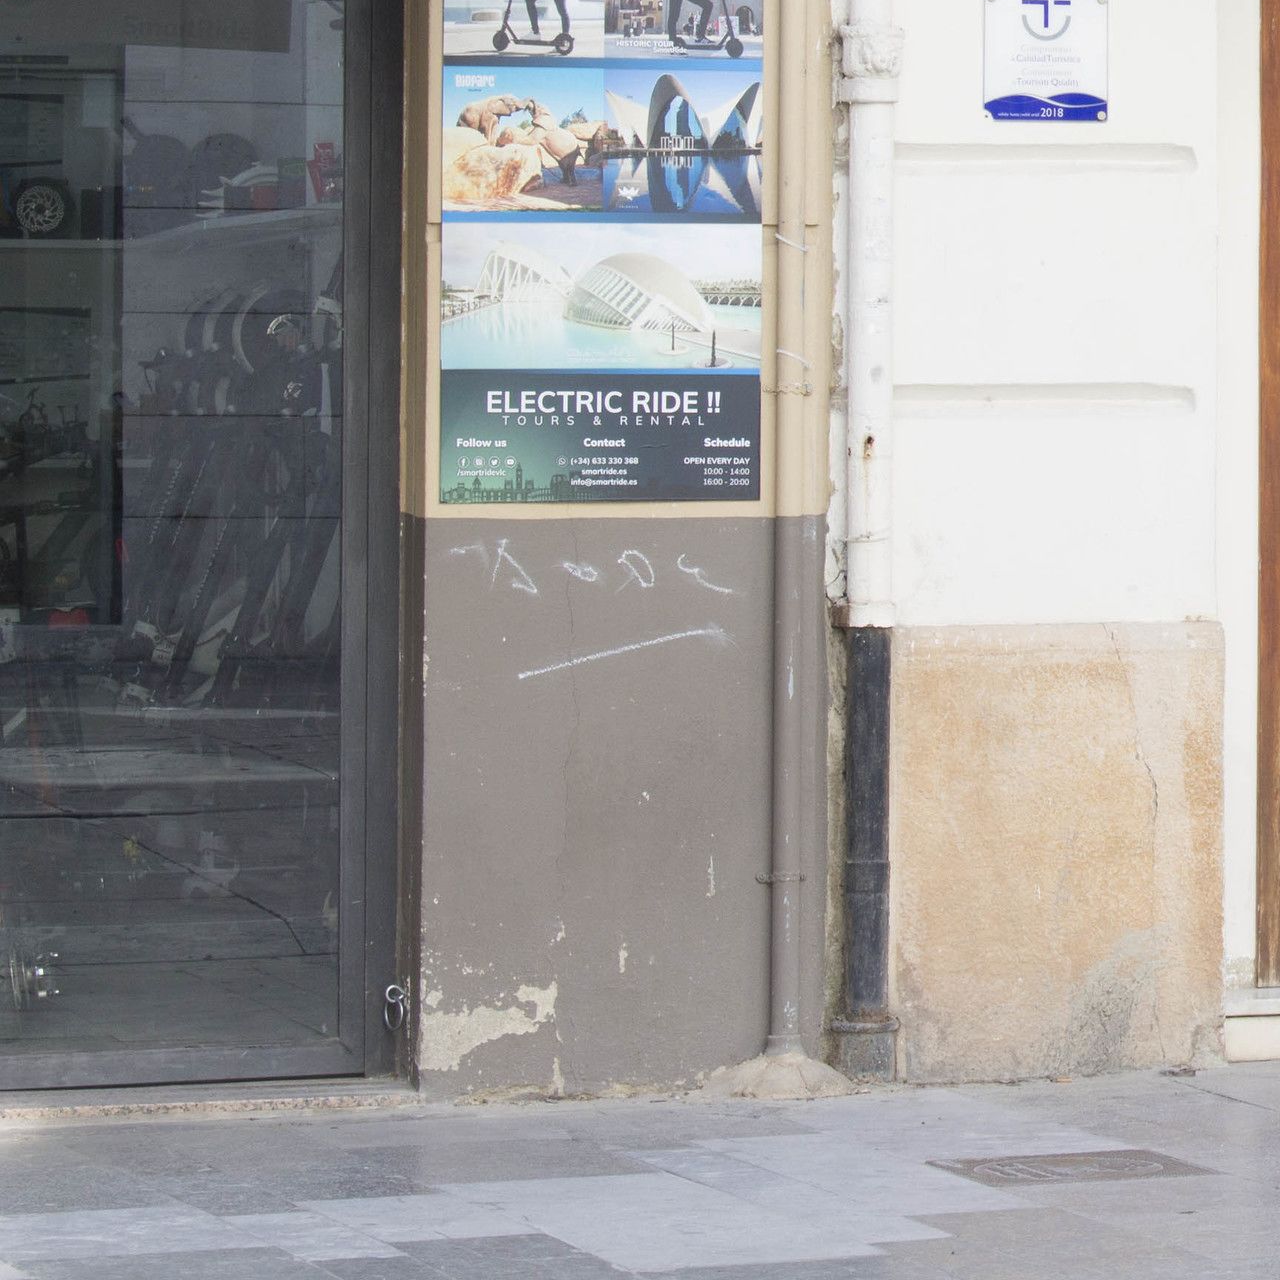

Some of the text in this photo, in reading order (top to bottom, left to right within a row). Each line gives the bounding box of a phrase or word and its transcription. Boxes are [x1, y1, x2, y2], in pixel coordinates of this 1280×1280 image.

[1041, 108, 1064, 118] 2018
[487, 390, 721, 414] ELECTRIC RIDE !!
[502, 415, 705, 426] TOURS & RENTAL
[456, 438, 507, 448] Follow us
[583, 438, 626, 448] Contact
[703, 437, 751, 448] Schedule
[570, 457, 639, 466] (+34) 633 330 368
[684, 457, 751, 465] OPEN EVERY DAY
[581, 467, 628, 475] smartride.es
[703, 467, 723, 476] 10:00
[730, 467, 750, 476] 14:00
[570, 477, 638, 487] info@smartride.es
[703, 478, 723, 486] 16:00
[729, 478, 750, 486] 20:00
